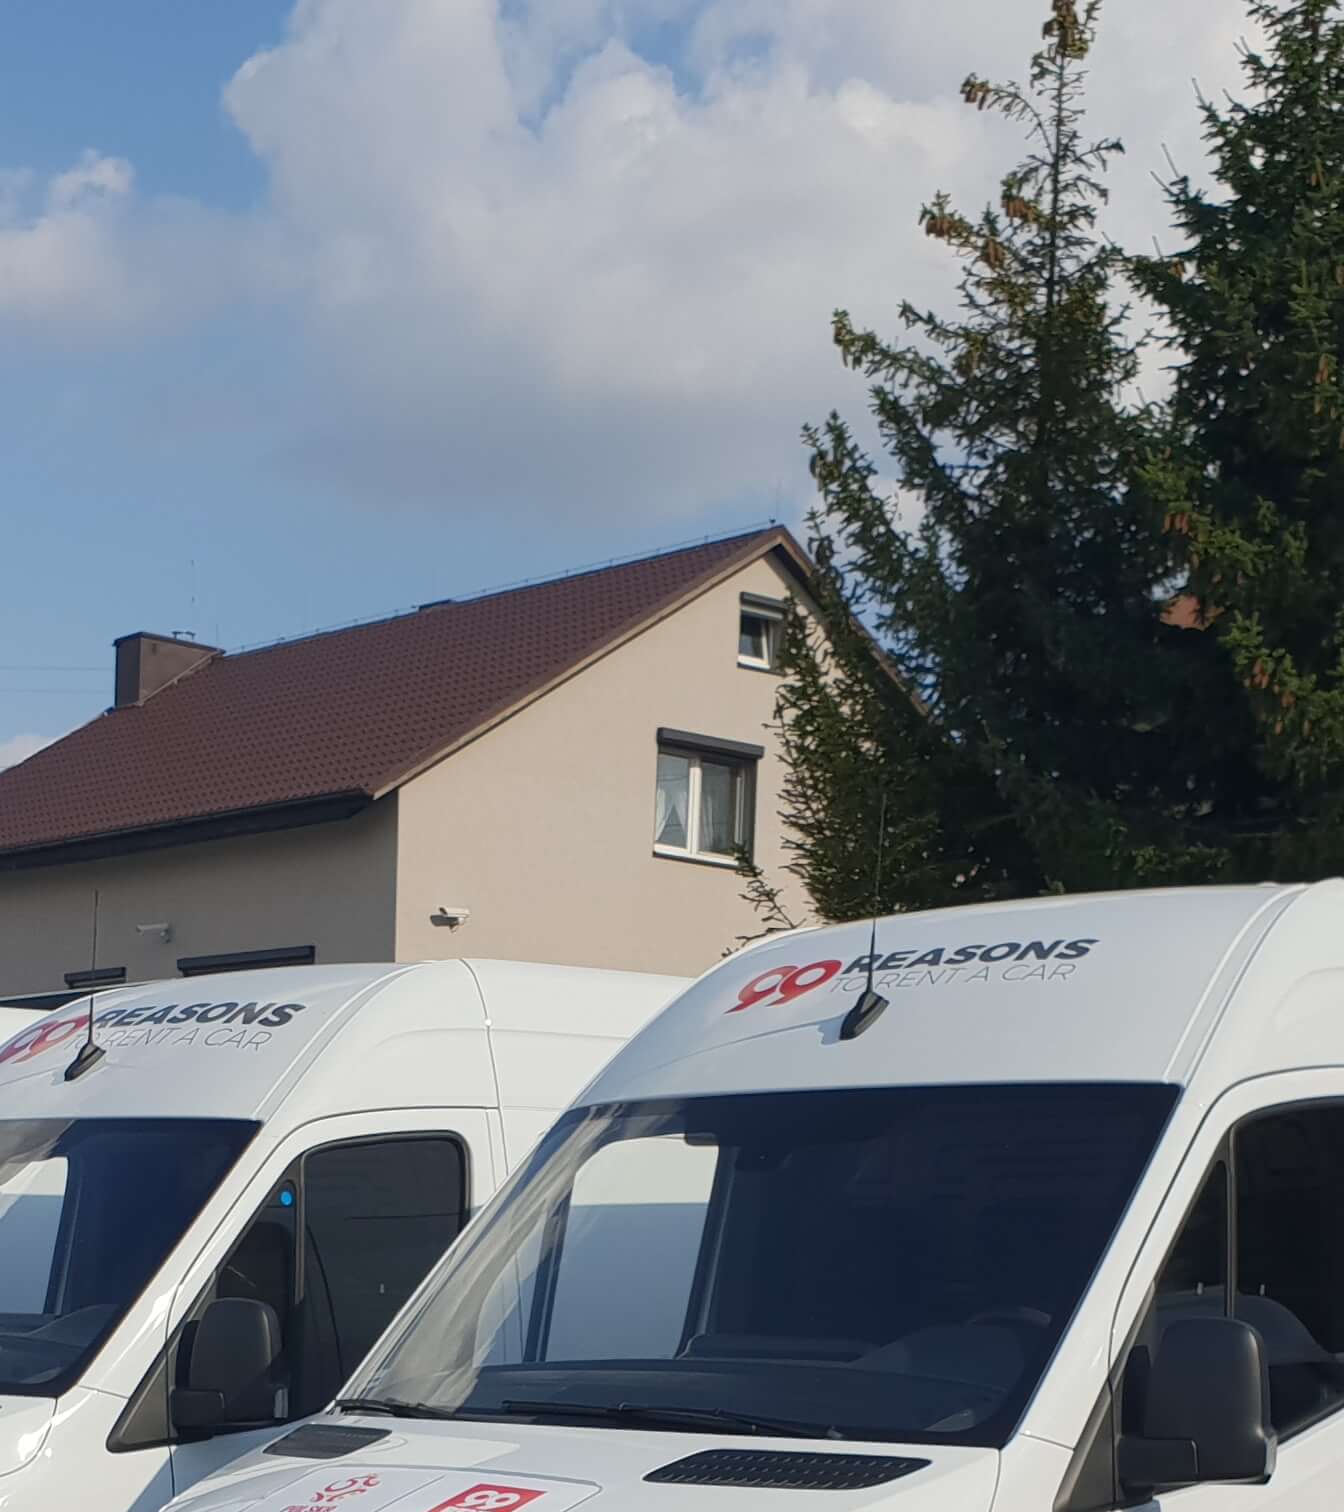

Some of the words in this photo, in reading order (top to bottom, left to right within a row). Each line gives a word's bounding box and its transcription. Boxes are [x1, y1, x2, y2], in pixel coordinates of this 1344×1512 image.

[724, 958, 843, 1014] 99
[841, 938, 1100, 976] REASONS
[874, 967, 966, 990] RENT
[965, 965, 991, 983] A
[1001, 962, 1078, 983] CAR
[94, 1001, 307, 1028] REASONS
[105, 1027, 181, 1046] RENT
[205, 1027, 273, 1052] CAR
[456, 1490, 521, 1511] 99
